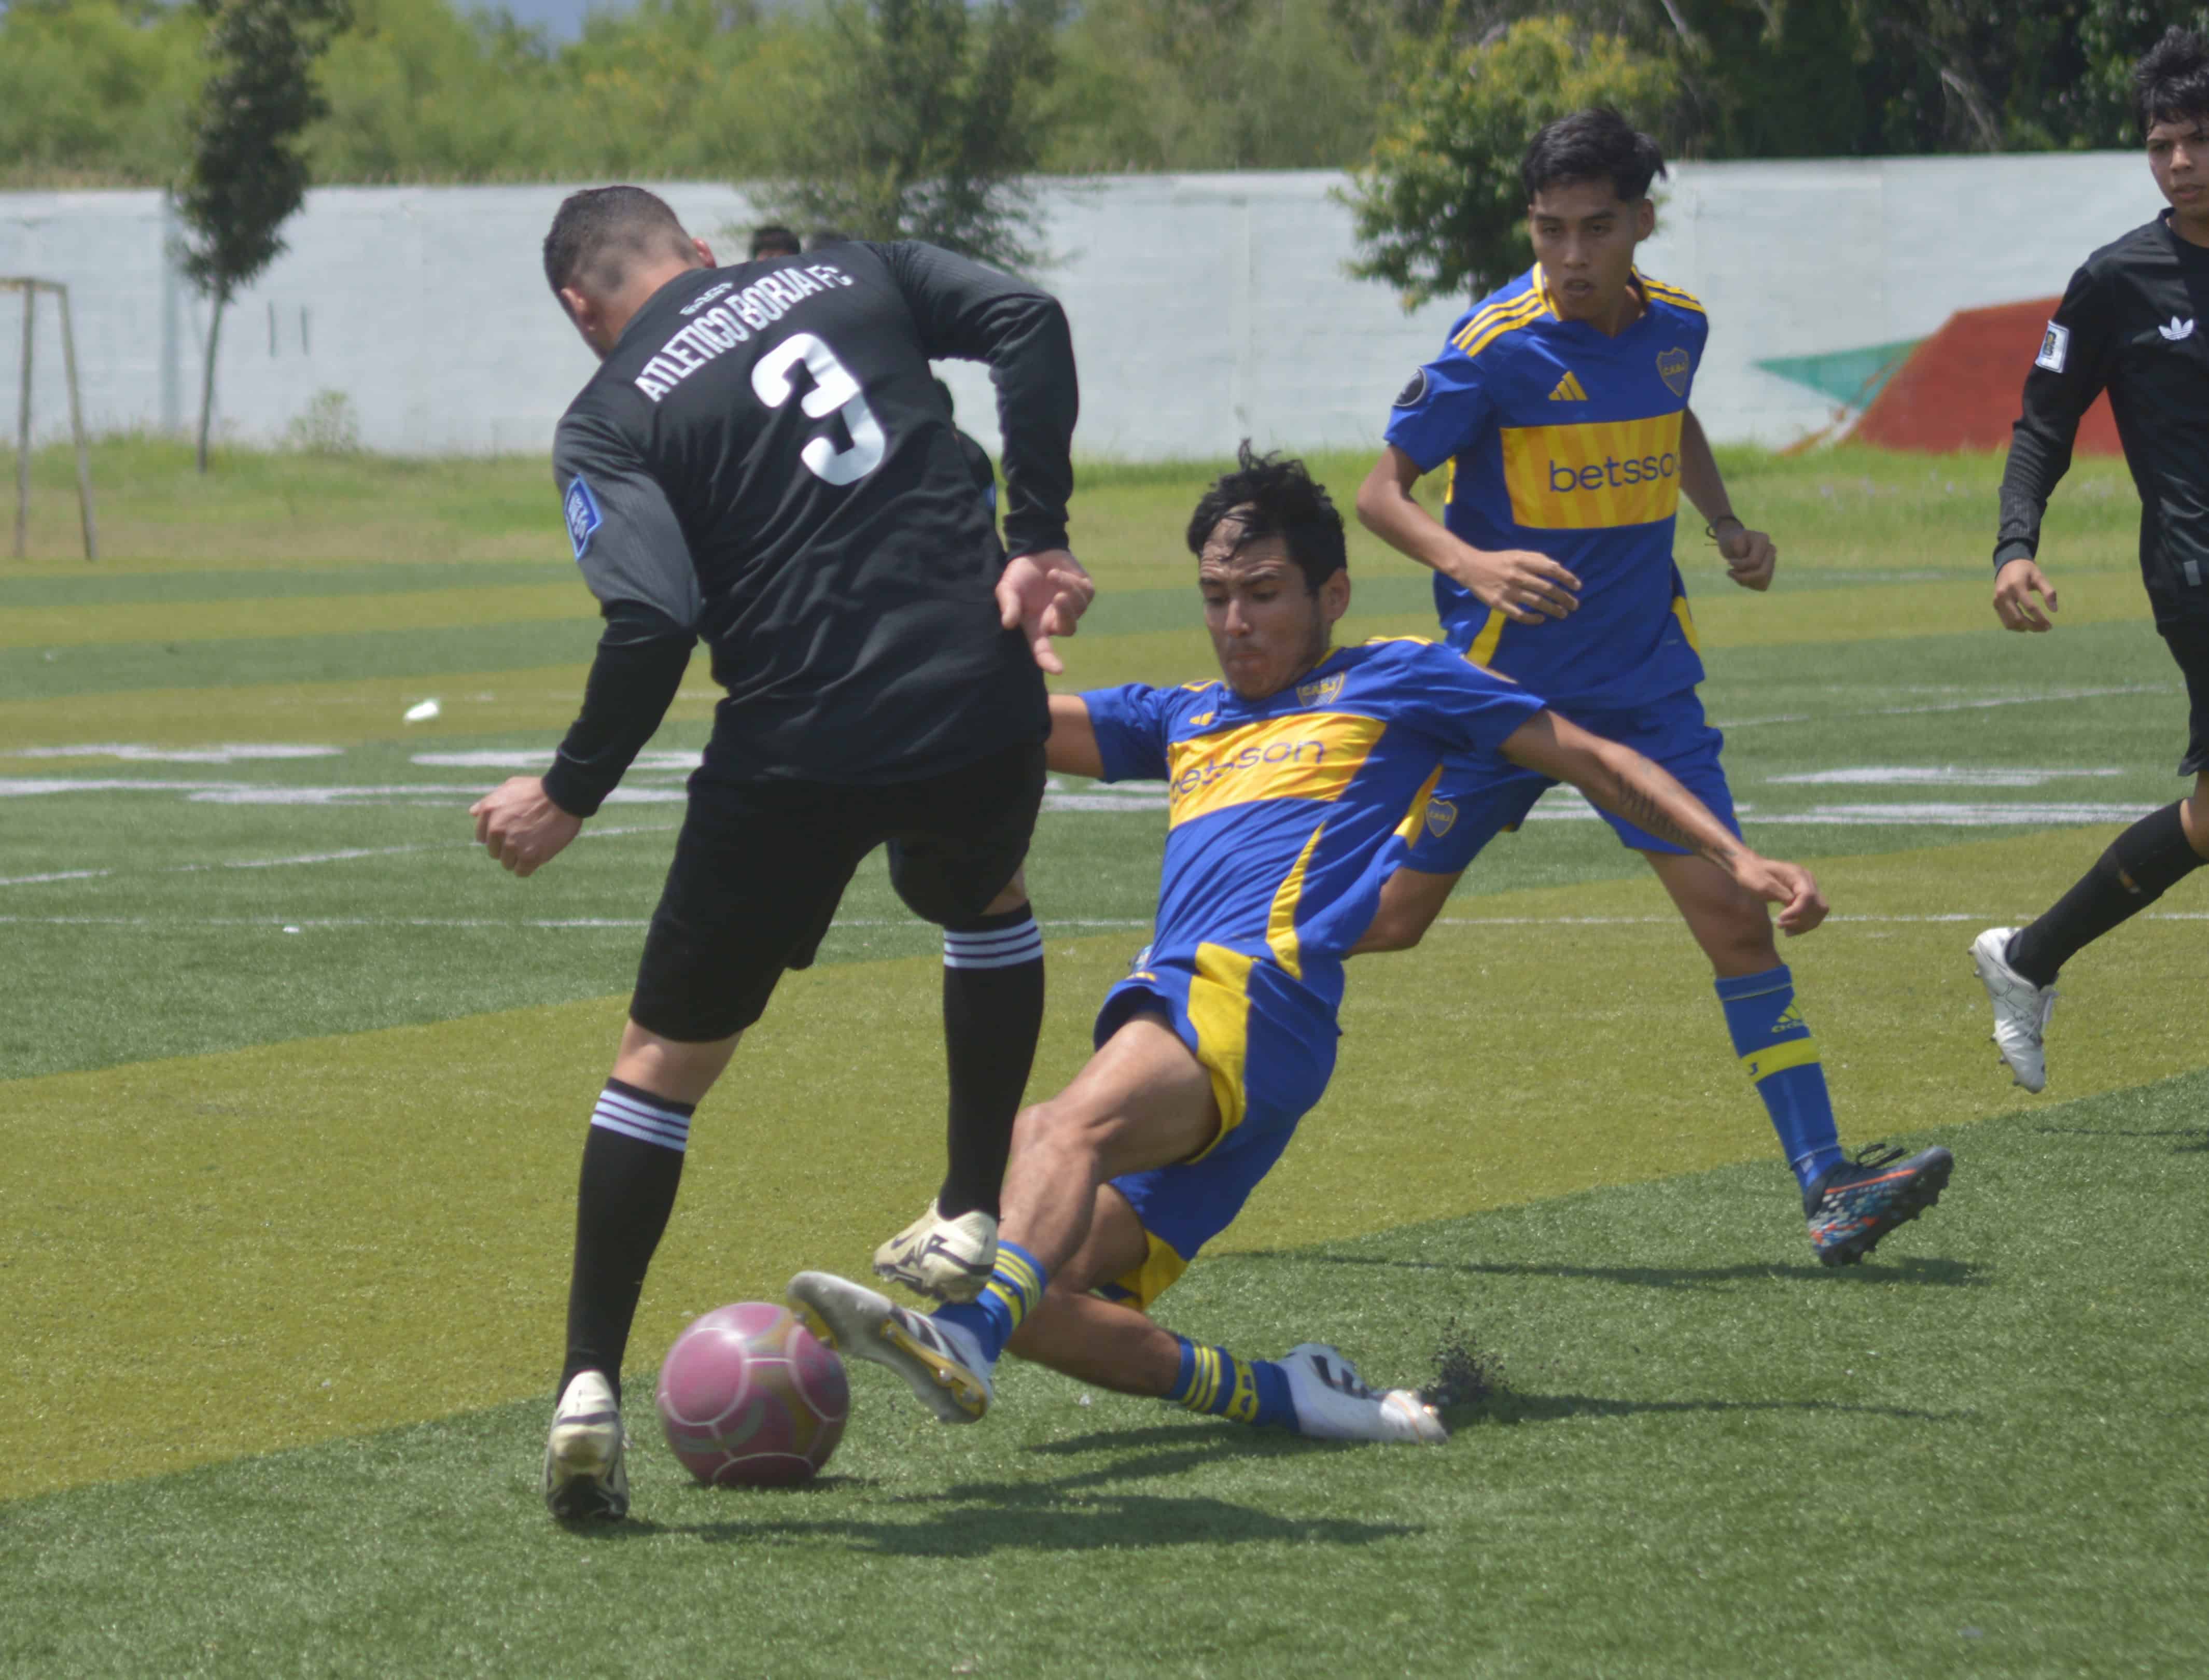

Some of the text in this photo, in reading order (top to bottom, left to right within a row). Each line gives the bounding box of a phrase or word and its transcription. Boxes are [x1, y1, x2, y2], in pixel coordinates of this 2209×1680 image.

[634, 307, 750, 402] ATLETICO
[723, 268, 823, 331] BORJA
[804, 264, 854, 288] FC
[751, 332, 886, 486] 3
[1549, 451, 1681, 493] betsso
